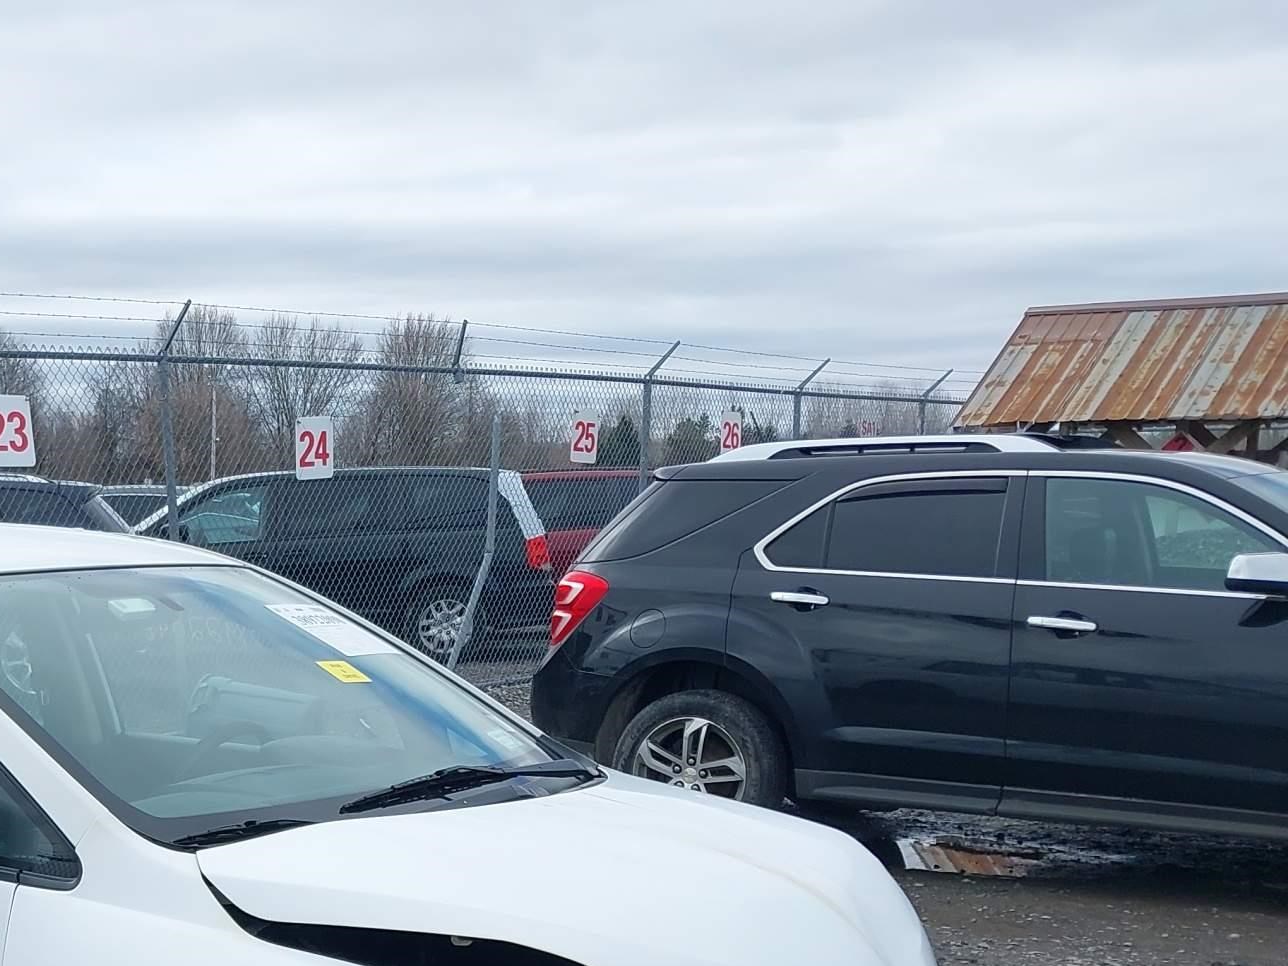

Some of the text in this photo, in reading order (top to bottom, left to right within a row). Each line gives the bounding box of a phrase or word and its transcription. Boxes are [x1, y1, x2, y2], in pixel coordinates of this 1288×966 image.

[299, 430, 330, 468] 24
[573, 421, 597, 453] 25
[721, 422, 740, 449] 26
